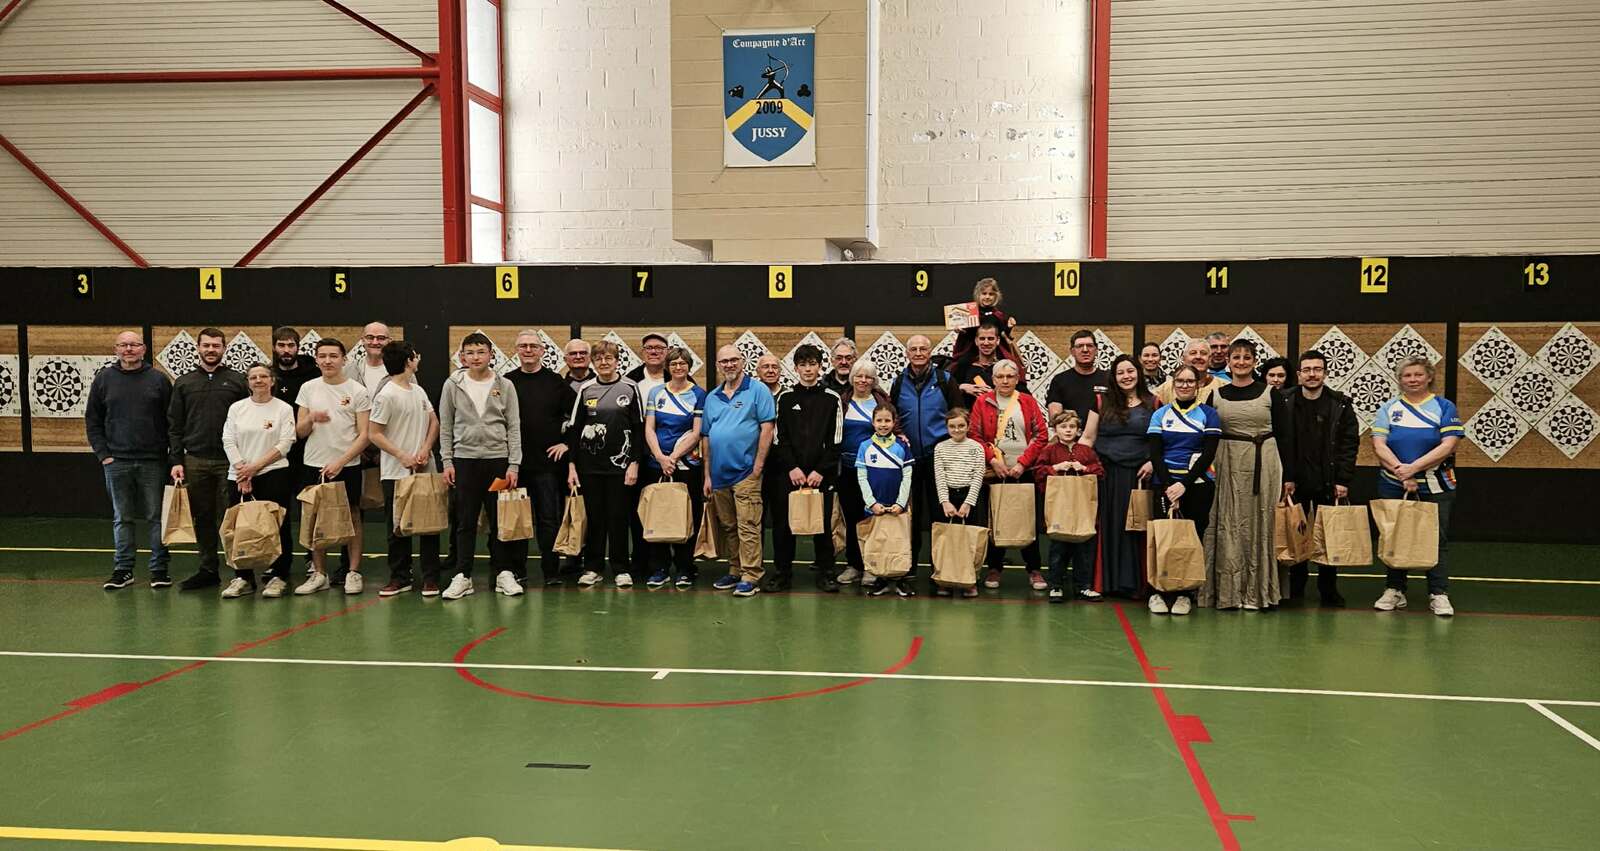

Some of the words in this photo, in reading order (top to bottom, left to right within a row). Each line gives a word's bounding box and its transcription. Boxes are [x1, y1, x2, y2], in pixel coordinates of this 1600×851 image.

[733, 39, 779, 48] Compagnie
[782, 36, 806, 47] d'Arc
[755, 101, 783, 114] 2009
[752, 127, 787, 142] JUSSY
[77, 273, 89, 294] 3
[205, 273, 217, 293] 4
[335, 273, 347, 294] 5
[501, 272, 513, 293] 6
[636, 271, 649, 292] 7
[775, 271, 786, 292] 8
[915, 270, 929, 292] 9
[1056, 269, 1078, 290] 10
[1206, 266, 1228, 289] 11
[1363, 264, 1387, 286] 12
[1524, 262, 1550, 286] 13
